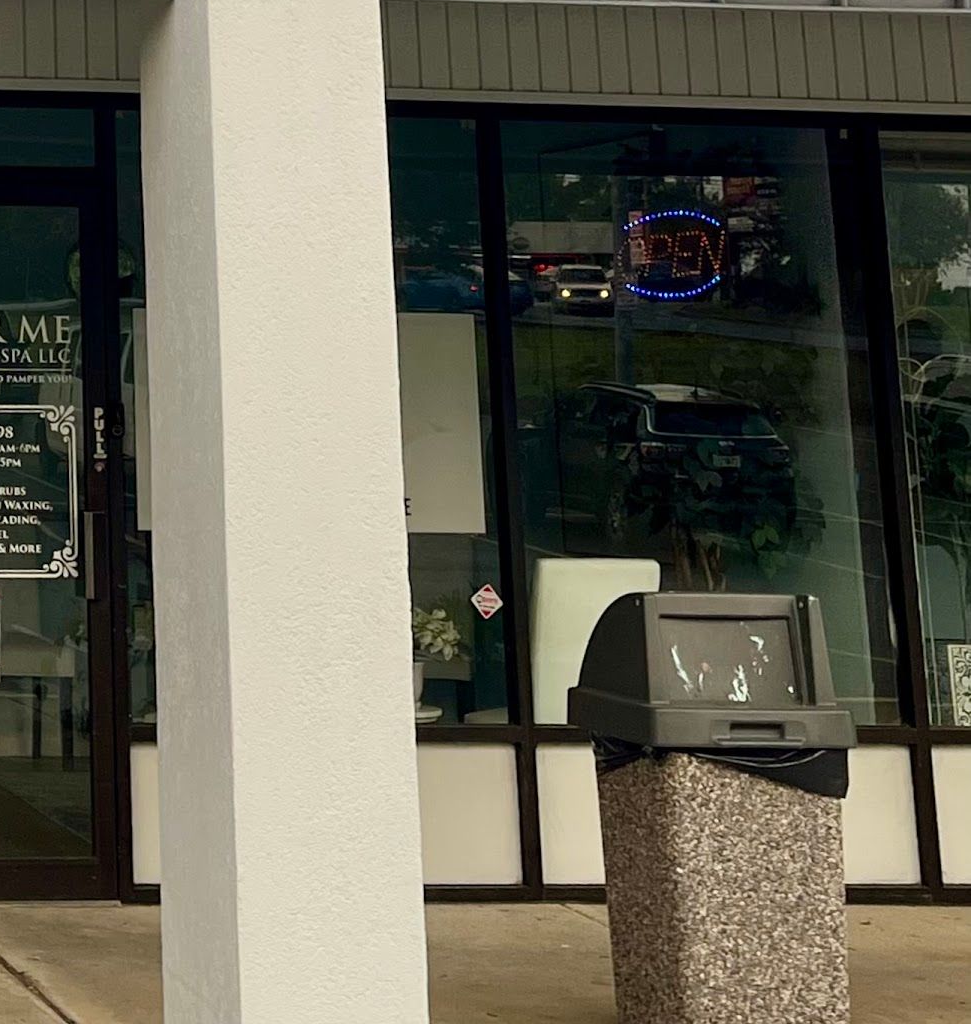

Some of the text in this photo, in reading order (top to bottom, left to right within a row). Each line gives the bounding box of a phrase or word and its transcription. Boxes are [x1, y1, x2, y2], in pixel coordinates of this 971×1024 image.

[18, 314, 71, 345] ME
[39, 347, 71, 364] LLC
[6, 374, 45, 384] PAMPER
[93, 407, 108, 454] PULL
[4, 501, 53, 511] WAXING,
[9, 544, 42, 554] MORE
